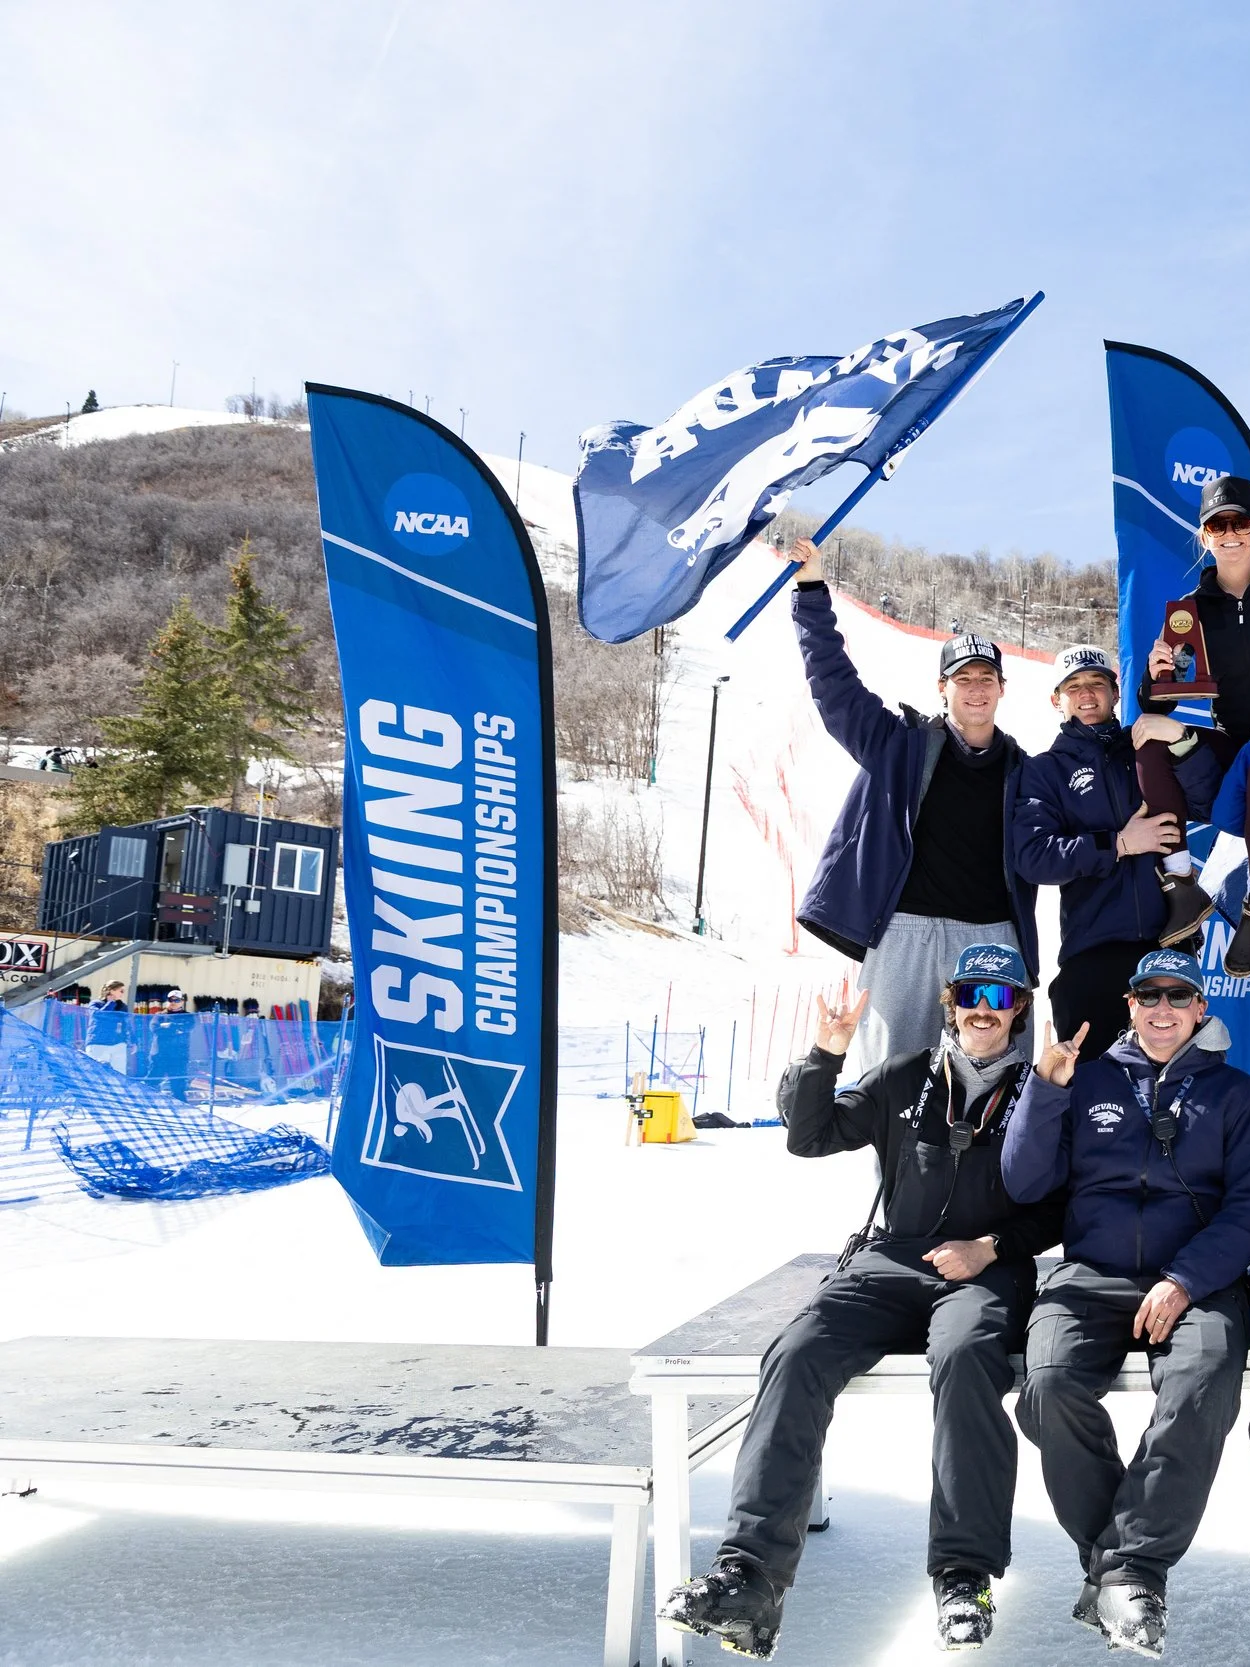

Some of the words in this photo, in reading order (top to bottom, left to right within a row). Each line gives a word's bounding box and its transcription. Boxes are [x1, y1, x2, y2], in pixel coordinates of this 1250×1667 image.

[1172, 462, 1231, 487] NCA
[394, 511, 469, 538] NCAA
[952, 635, 968, 650] SAVE
[968, 634, 974, 645] A
[955, 645, 971, 660] RIDE
[970, 644, 978, 656] A
[1064, 649, 1105, 669] SKIING
[359, 698, 463, 1033] SKIING
[473, 711, 517, 1036] CHAMPIONSHIPS
[1088, 1103, 1125, 1115] NEVADA
